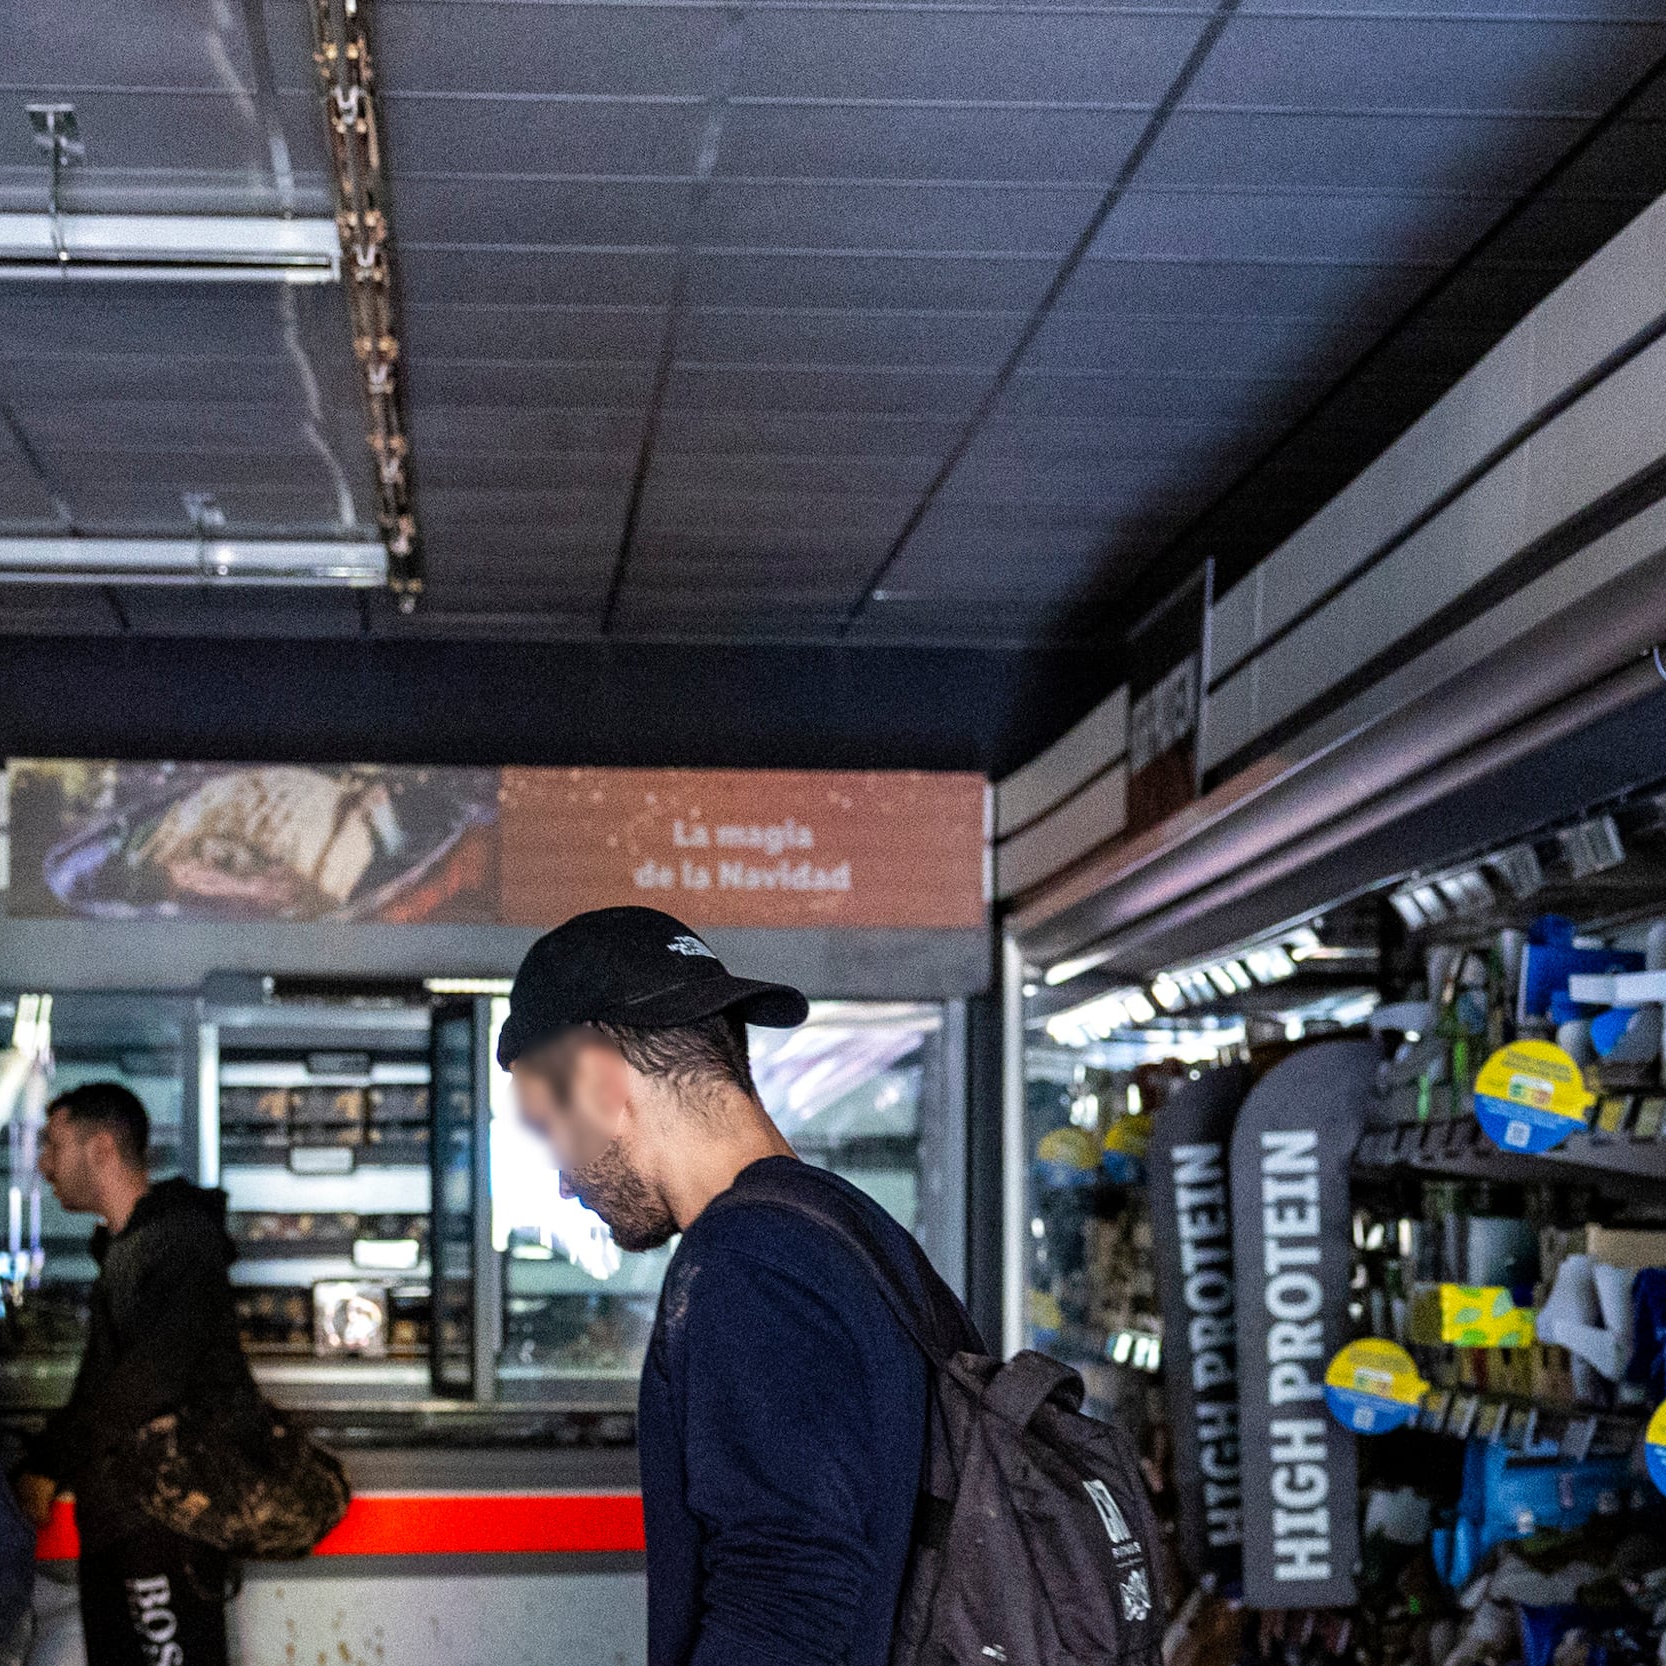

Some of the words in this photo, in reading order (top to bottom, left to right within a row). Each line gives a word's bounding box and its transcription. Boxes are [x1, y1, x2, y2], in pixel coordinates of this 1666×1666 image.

[634, 861, 674, 889] de
[682, 861, 711, 889] la
[718, 861, 852, 892] Navidad
[673, 819, 710, 847] La
[715, 818, 813, 857] magia
[1261, 1128, 1326, 1405] PROTEIN
[1271, 1418, 1332, 1582] HIGH
